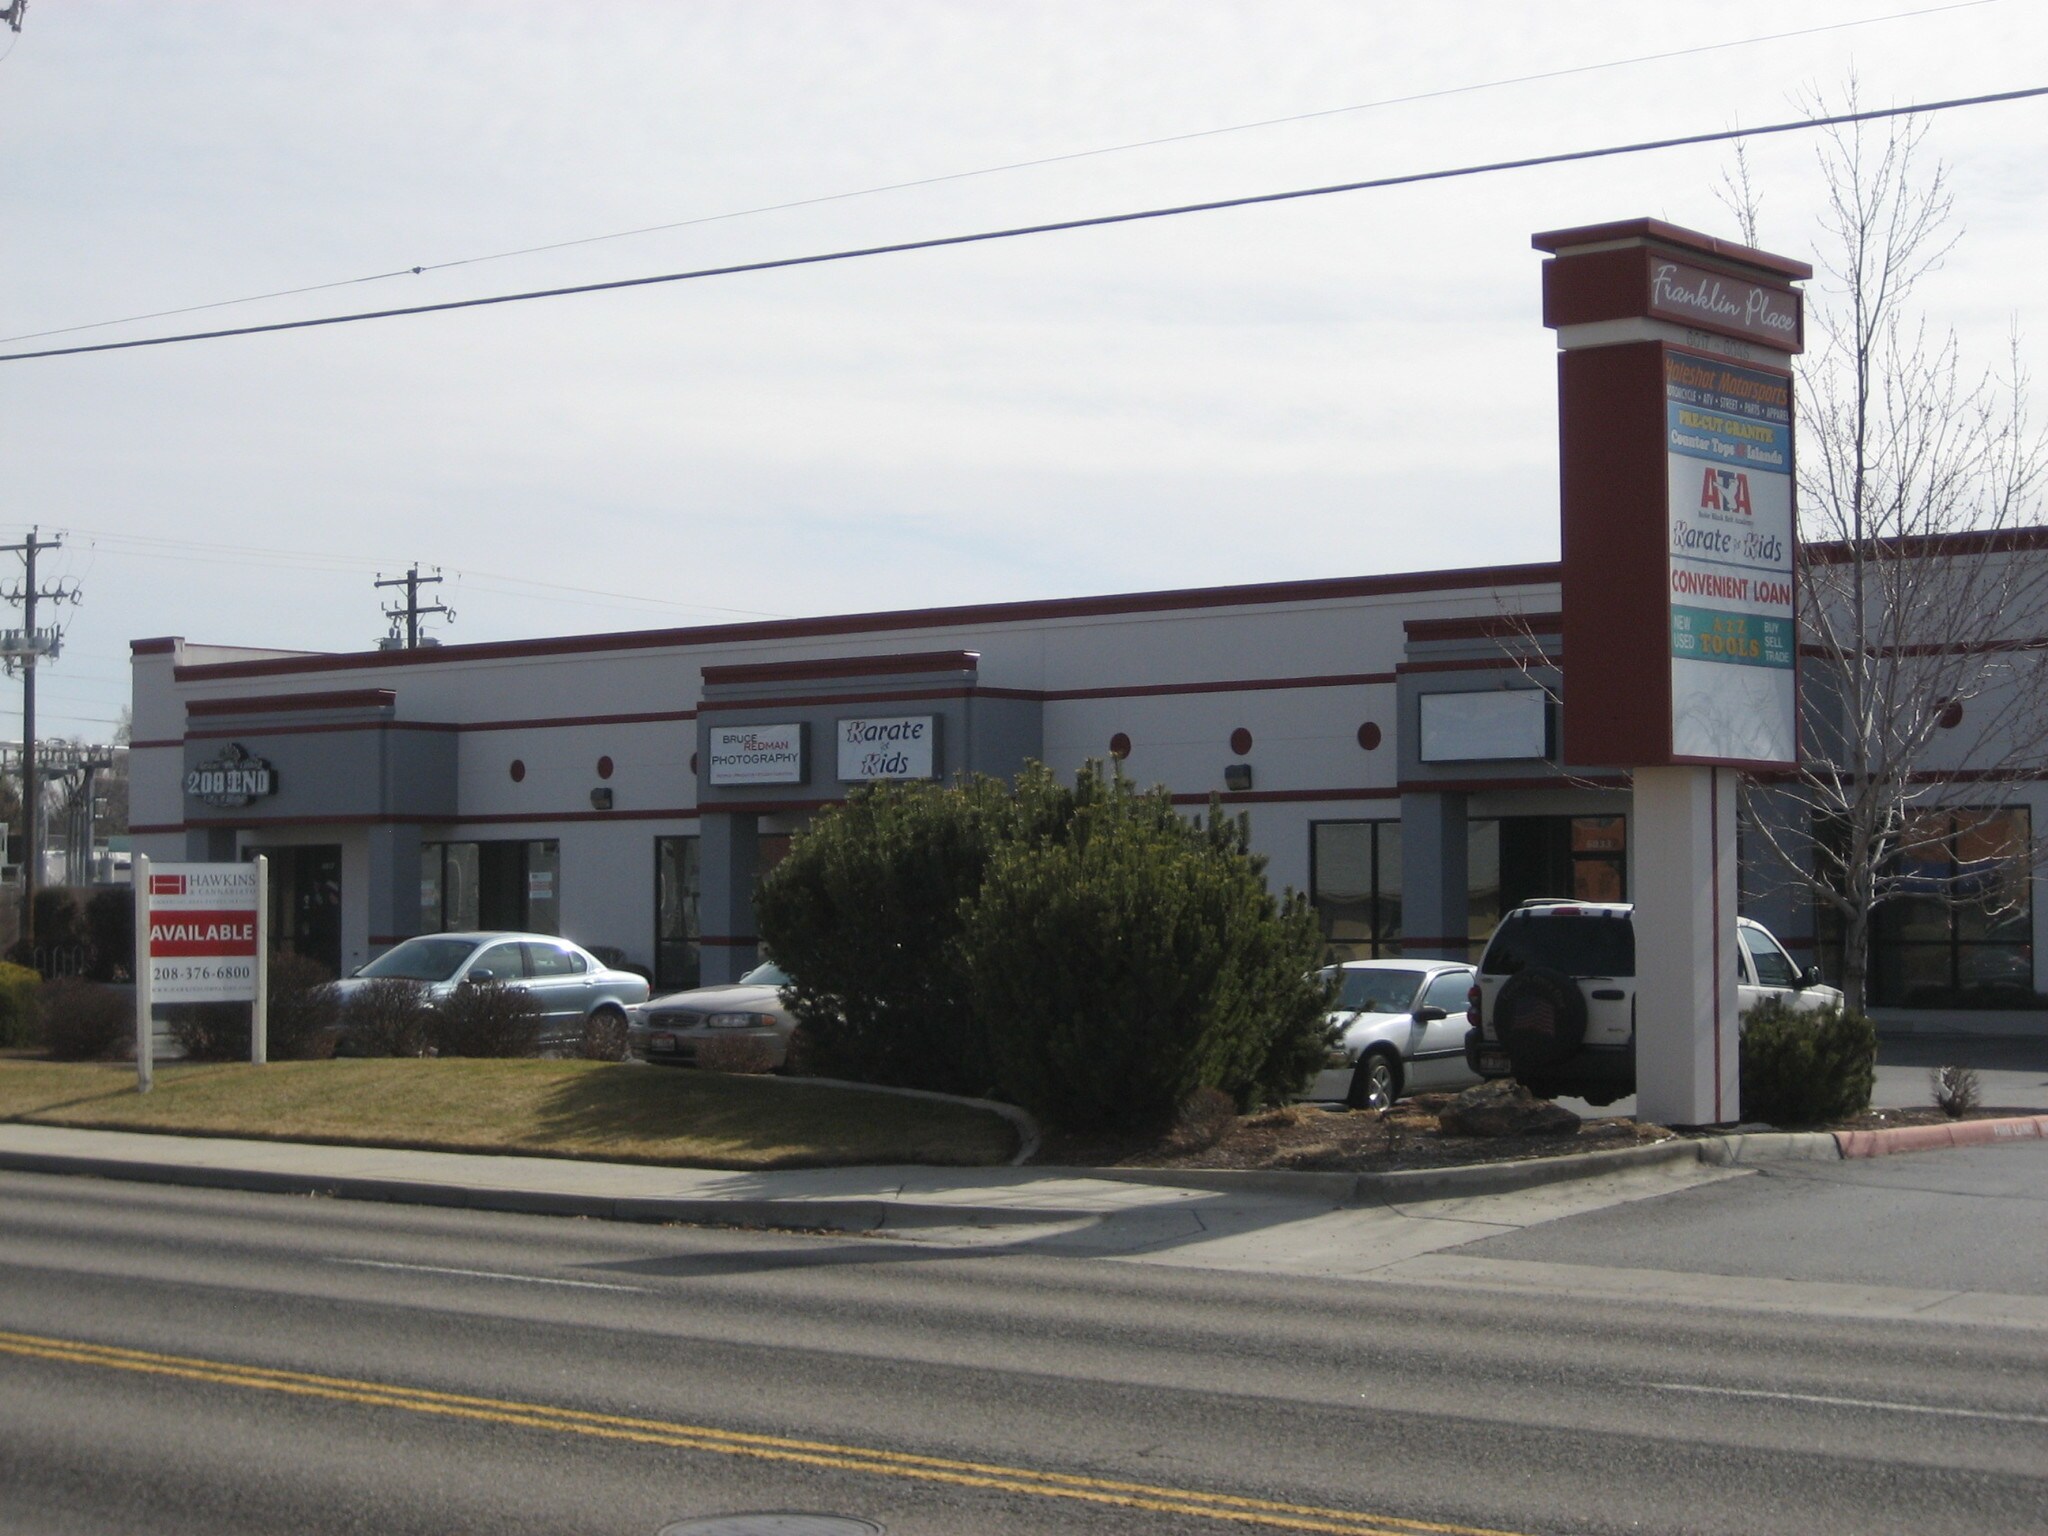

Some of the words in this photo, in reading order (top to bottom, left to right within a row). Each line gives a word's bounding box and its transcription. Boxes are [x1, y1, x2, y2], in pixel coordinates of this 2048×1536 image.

[1653, 265, 1740, 315] Franklin
[1746, 288, 1795, 330] Place
[1671, 428, 1710, 450] Counter
[1701, 467, 1752, 515] ATA
[1673, 520, 1731, 553] Karate
[1743, 532, 1782, 562] Kids
[1671, 569, 1749, 600] CONVENIENT
[1753, 580, 1791, 605] LOAN
[1673, 615, 1691, 631] NEW
[1763, 621, 1779, 634] BUY
[1673, 633, 1695, 649] USED
[1700, 633, 1760, 657] TOOLS
[1764, 636, 1783, 648] SELL
[1765, 650, 1790, 662] TRADE
[722, 734, 757, 744] BRUCE
[847, 721, 924, 744] Karate
[743, 741, 789, 751] REDMAN
[711, 753, 798, 765] PHOTOGRAPHY
[861, 752, 909, 776] Kids
[190, 874, 256, 886] HAWKINS
[150, 924, 253, 941] AVAILABLE
[153, 966, 250, 980] 208-376-6800
